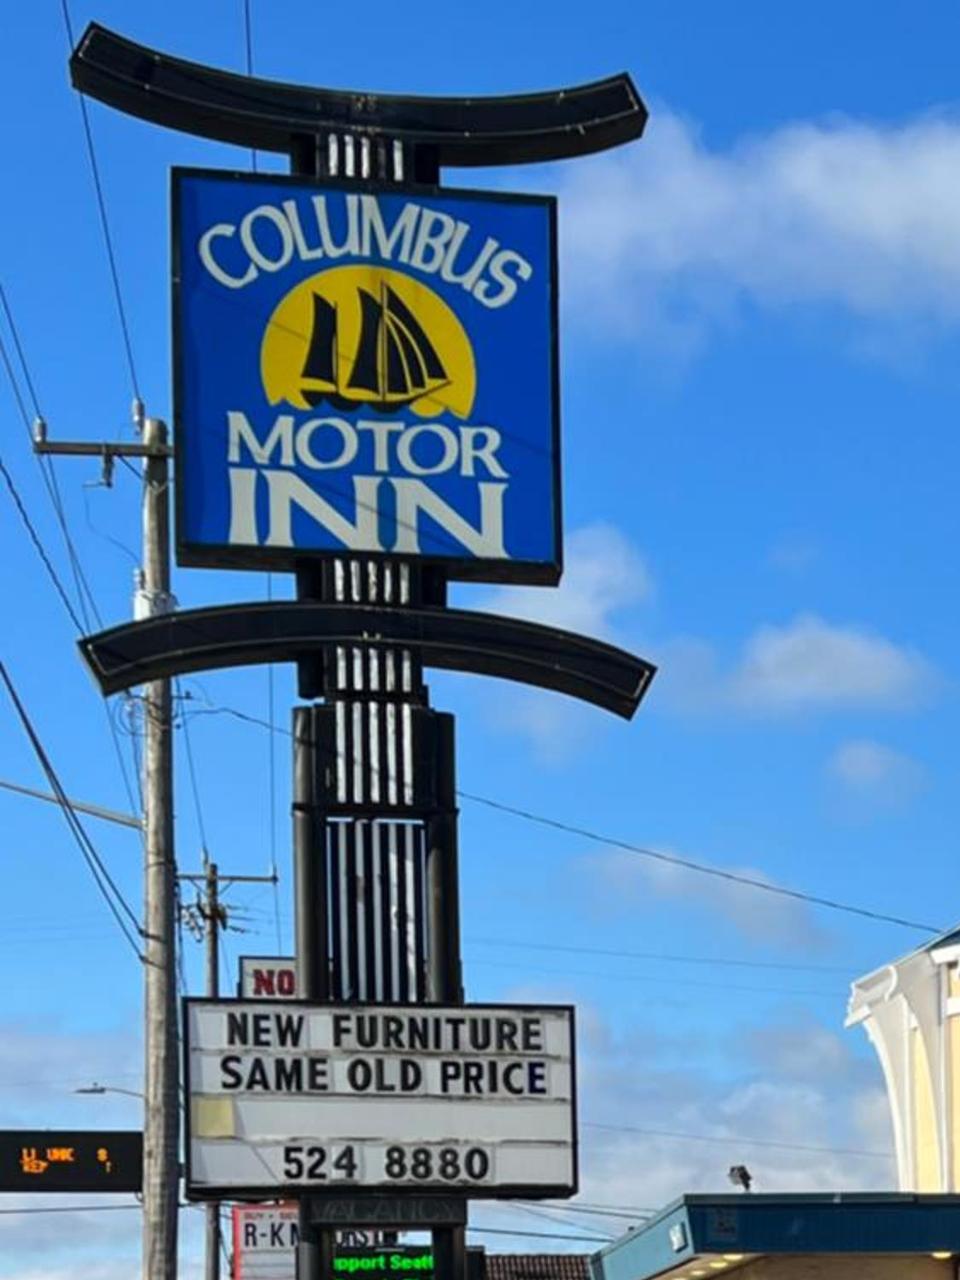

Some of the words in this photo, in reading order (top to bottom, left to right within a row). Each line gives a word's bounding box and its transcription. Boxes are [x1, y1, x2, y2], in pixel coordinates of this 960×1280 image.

[198, 193, 533, 309] COLUMBUS
[227, 410, 510, 479] MOTOR
[228, 467, 512, 560] INN
[252, 968, 296, 996] NO
[226, 1012, 304, 1048] NEW
[331, 1014, 543, 1052] FURNITURE
[220, 1055, 329, 1092] SAME
[346, 1058, 423, 1093] OLD
[440, 1060, 547, 1096] PRICE
[283, 1146, 357, 1181] 524
[385, 1148, 490, 1181] 8880
